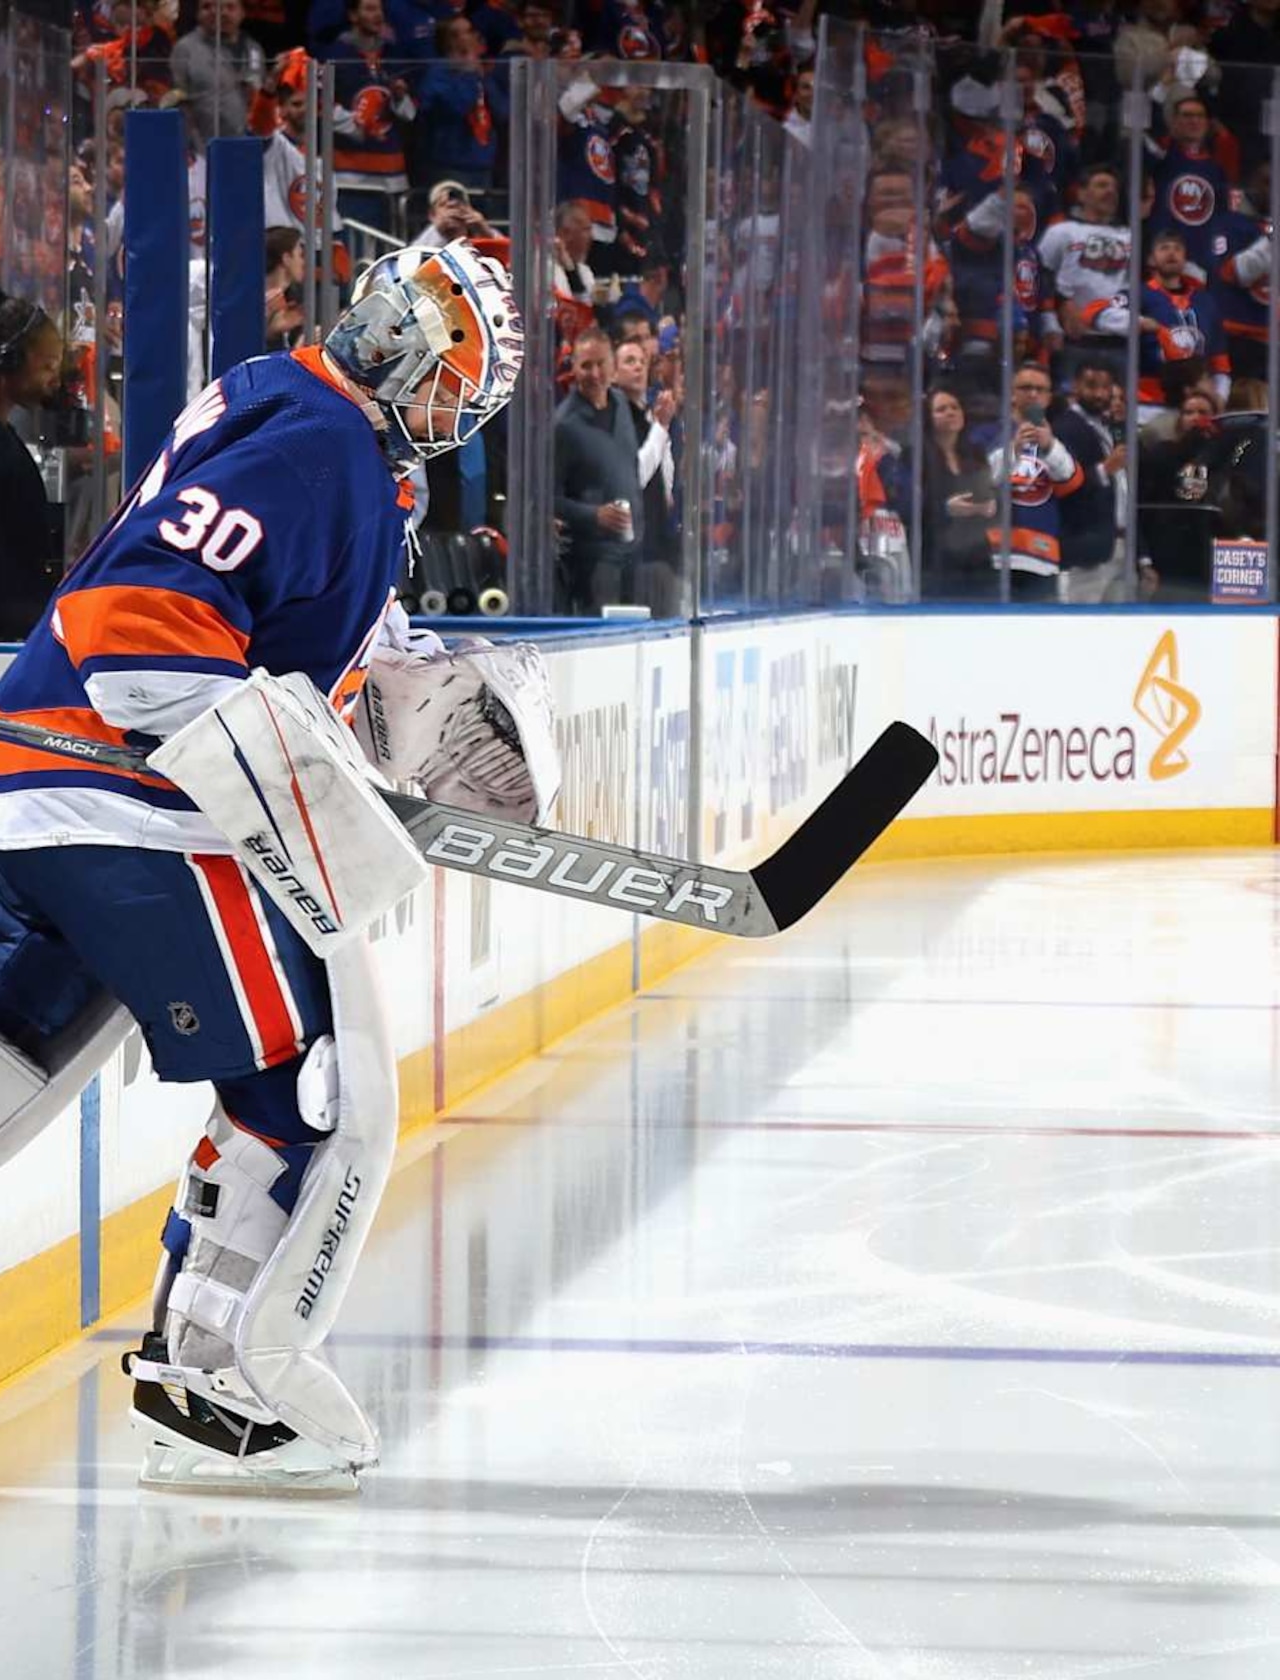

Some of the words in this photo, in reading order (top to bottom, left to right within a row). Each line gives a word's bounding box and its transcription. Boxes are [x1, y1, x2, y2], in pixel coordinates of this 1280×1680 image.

[158, 486, 263, 572] 30
[1216, 568, 1264, 586] CORNER
[43, 735, 99, 758] MACH
[924, 713, 1137, 786] AstraZeneca
[242, 831, 340, 935] BAUER
[425, 824, 734, 924] BAUER
[294, 1165, 361, 1321] SUPREME
